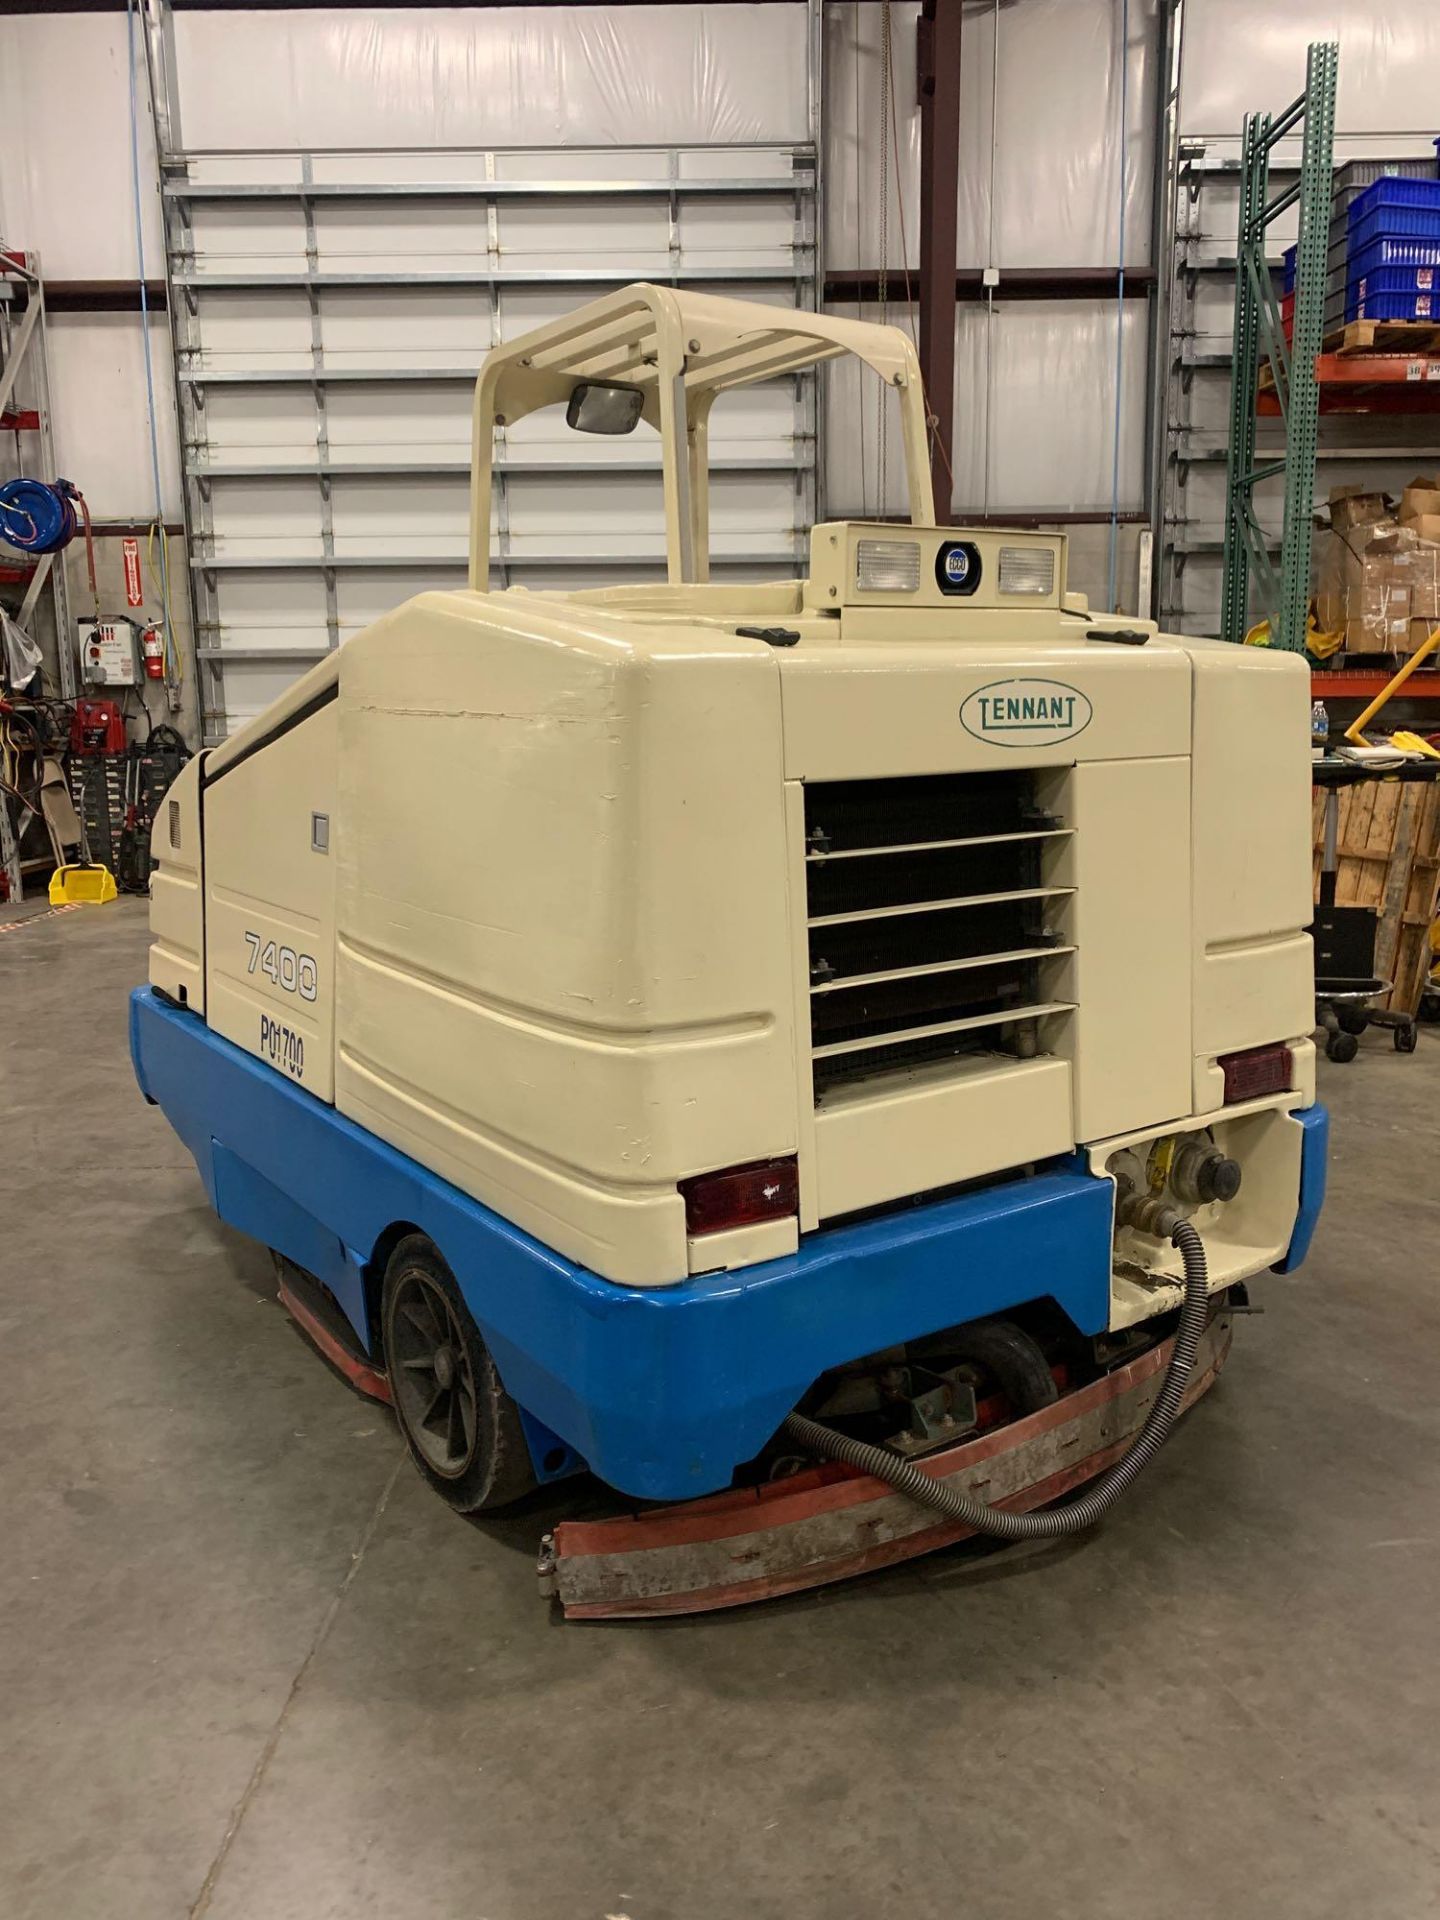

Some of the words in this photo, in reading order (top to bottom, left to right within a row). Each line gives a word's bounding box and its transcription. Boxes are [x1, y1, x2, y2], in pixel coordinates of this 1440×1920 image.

[949, 556, 966, 571] ECCO
[978, 697, 1076, 730] TENNANT
[245, 930, 318, 1003] 7400
[260, 1013, 304, 1079] P01700
